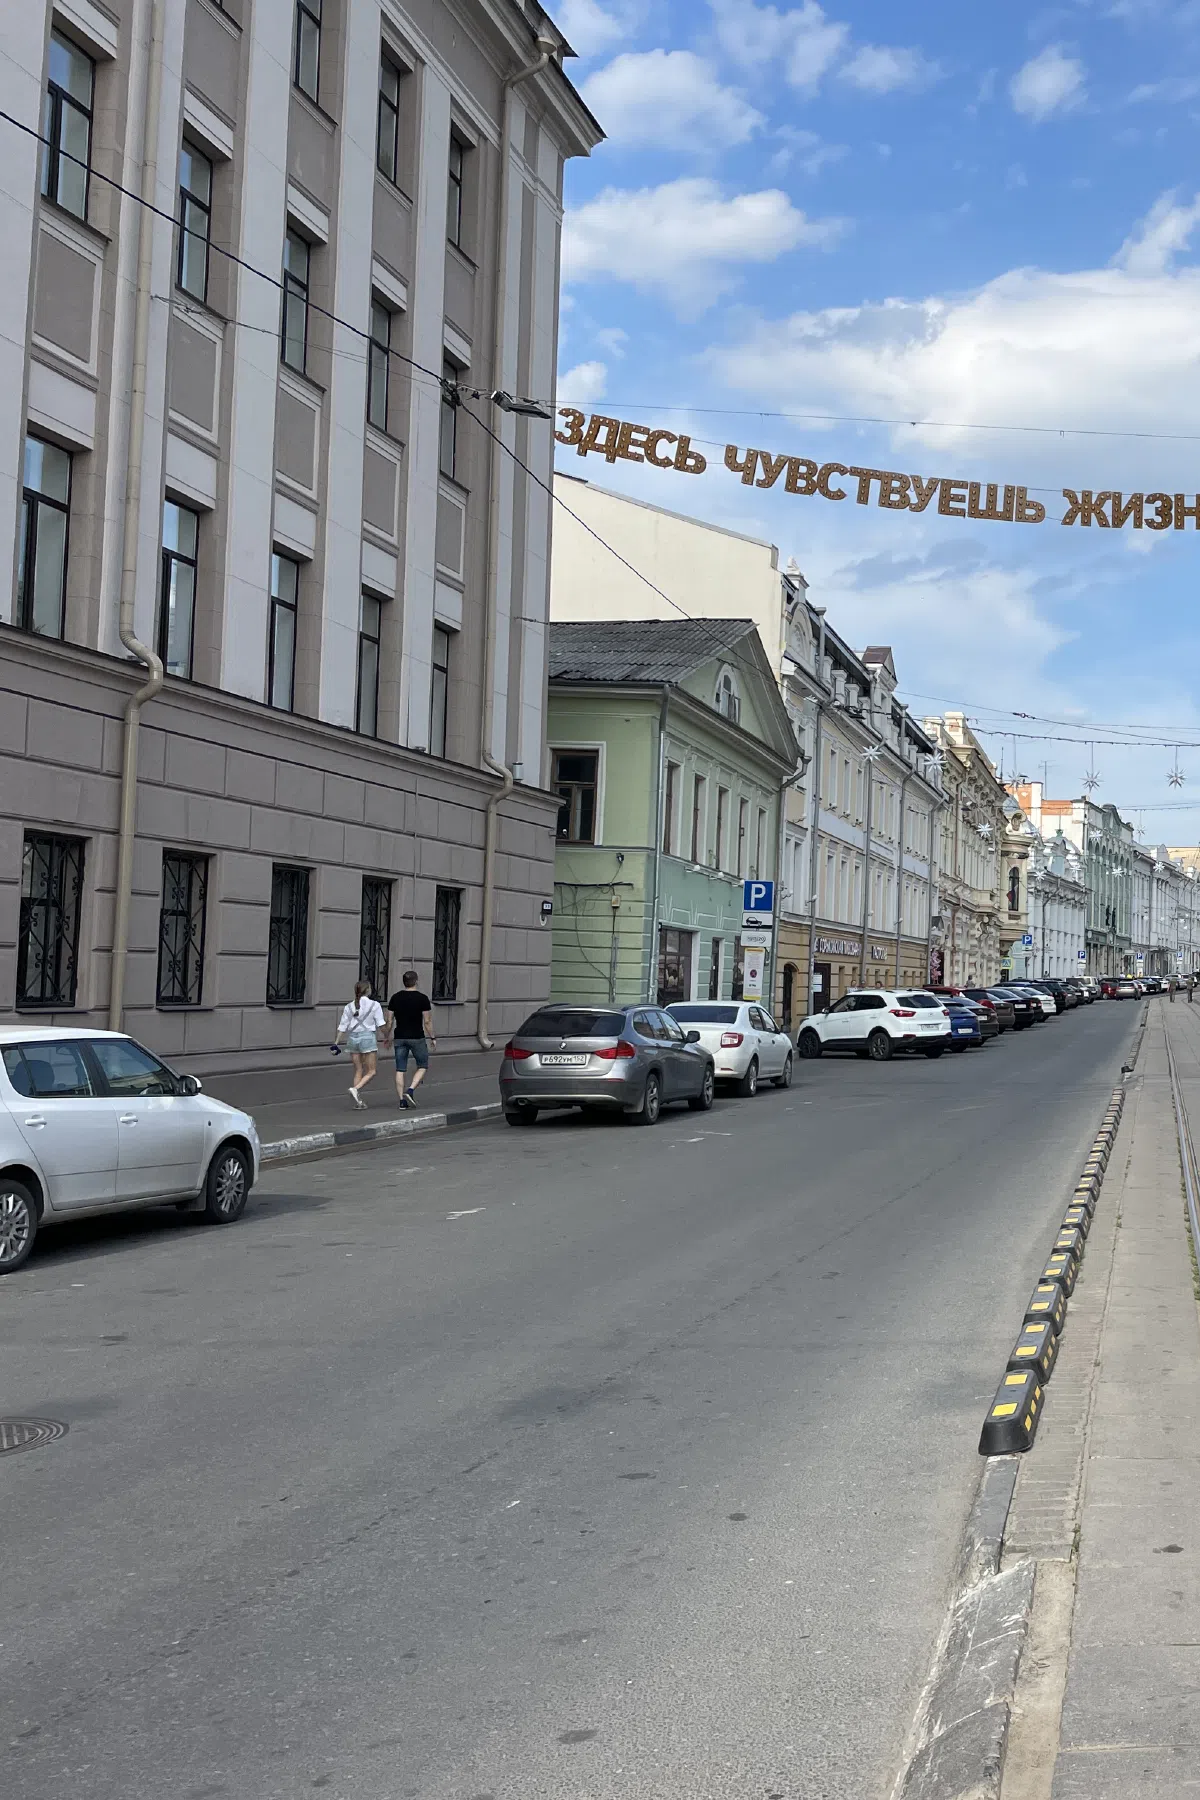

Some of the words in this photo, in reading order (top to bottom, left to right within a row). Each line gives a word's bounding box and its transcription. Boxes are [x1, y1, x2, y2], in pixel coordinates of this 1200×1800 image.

[554, 407, 708, 475] ЗДЕСЬ
[724, 444, 1047, 524] ЧУВСТВУЕШЬ
[750, 883, 766, 909] P
